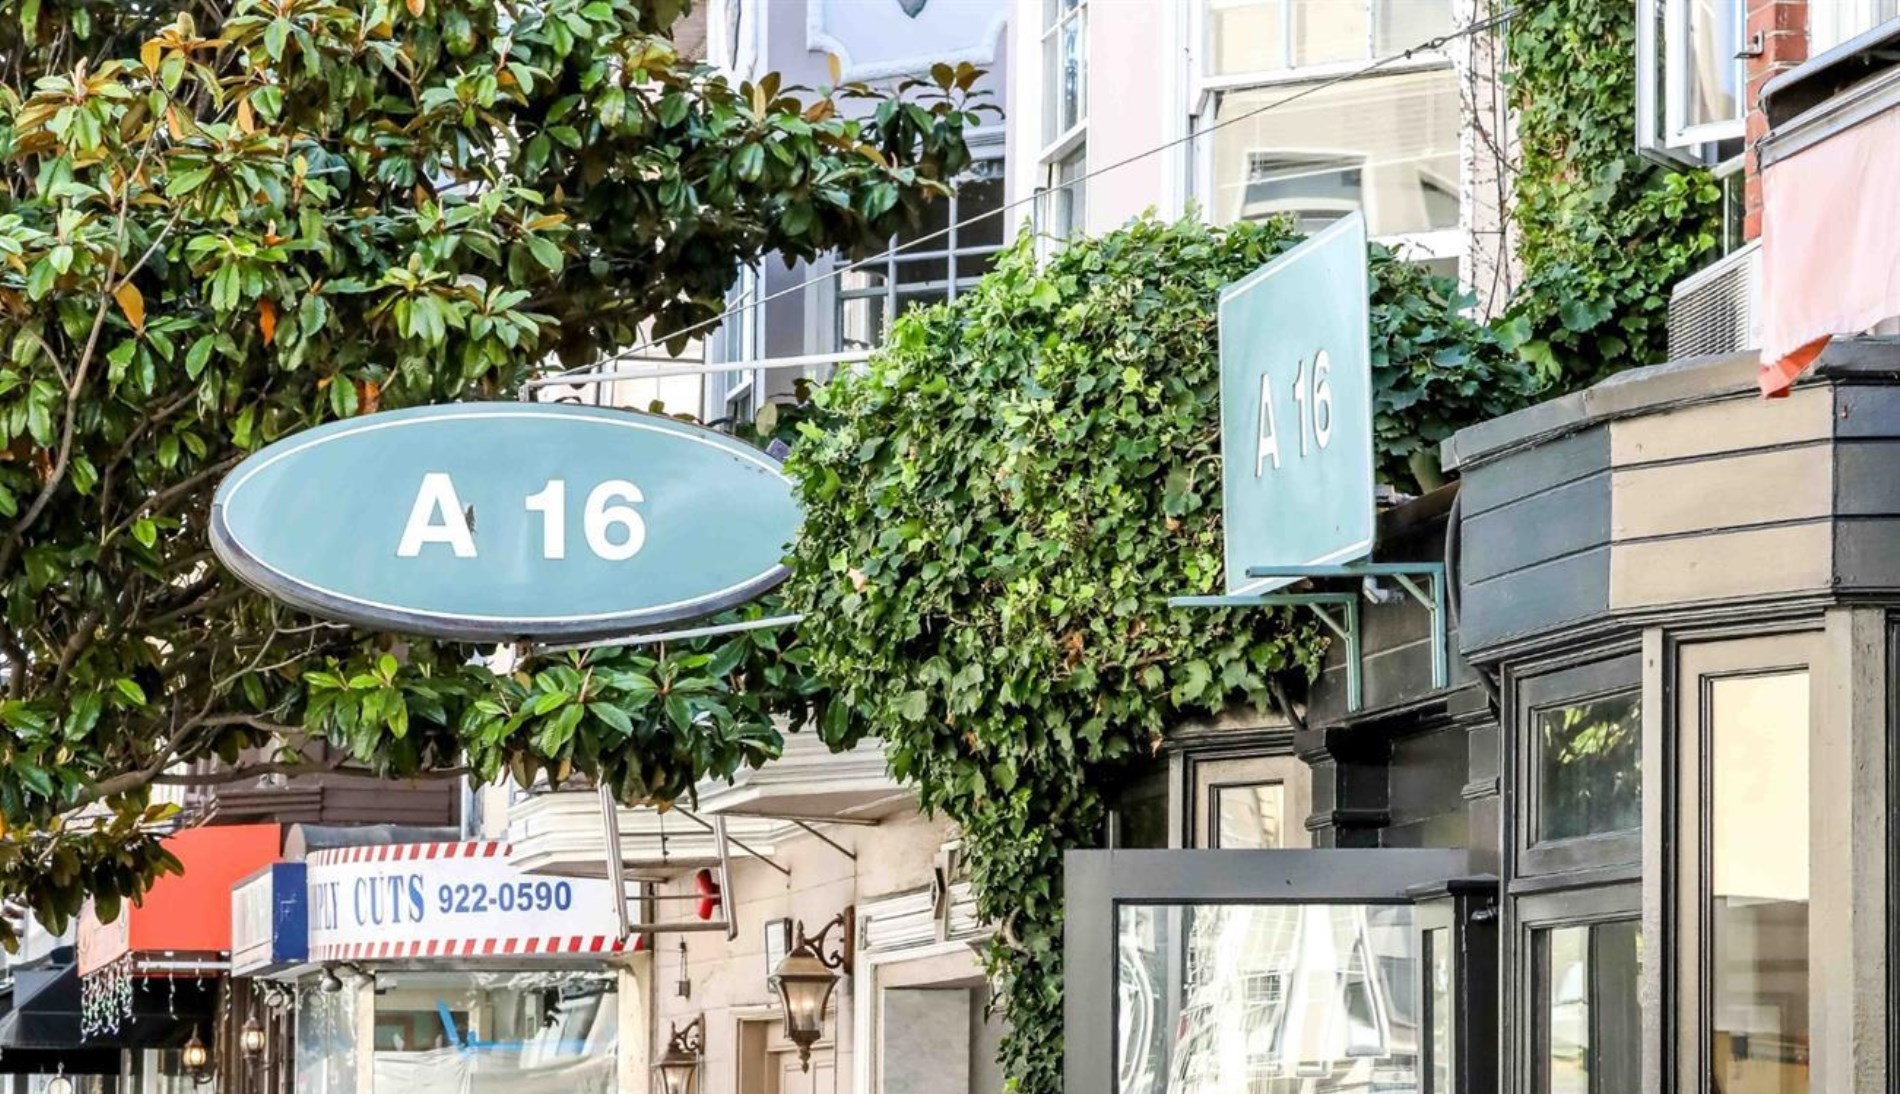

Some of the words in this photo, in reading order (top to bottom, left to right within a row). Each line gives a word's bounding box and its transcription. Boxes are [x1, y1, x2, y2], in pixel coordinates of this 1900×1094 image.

[1256, 372, 1281, 478] A
[1292, 349, 1333, 457] 16
[396, 472, 478, 558] A
[525, 479, 646, 561] 16
[353, 873, 426, 927] CUTS
[438, 880, 572, 914] 922-0590
